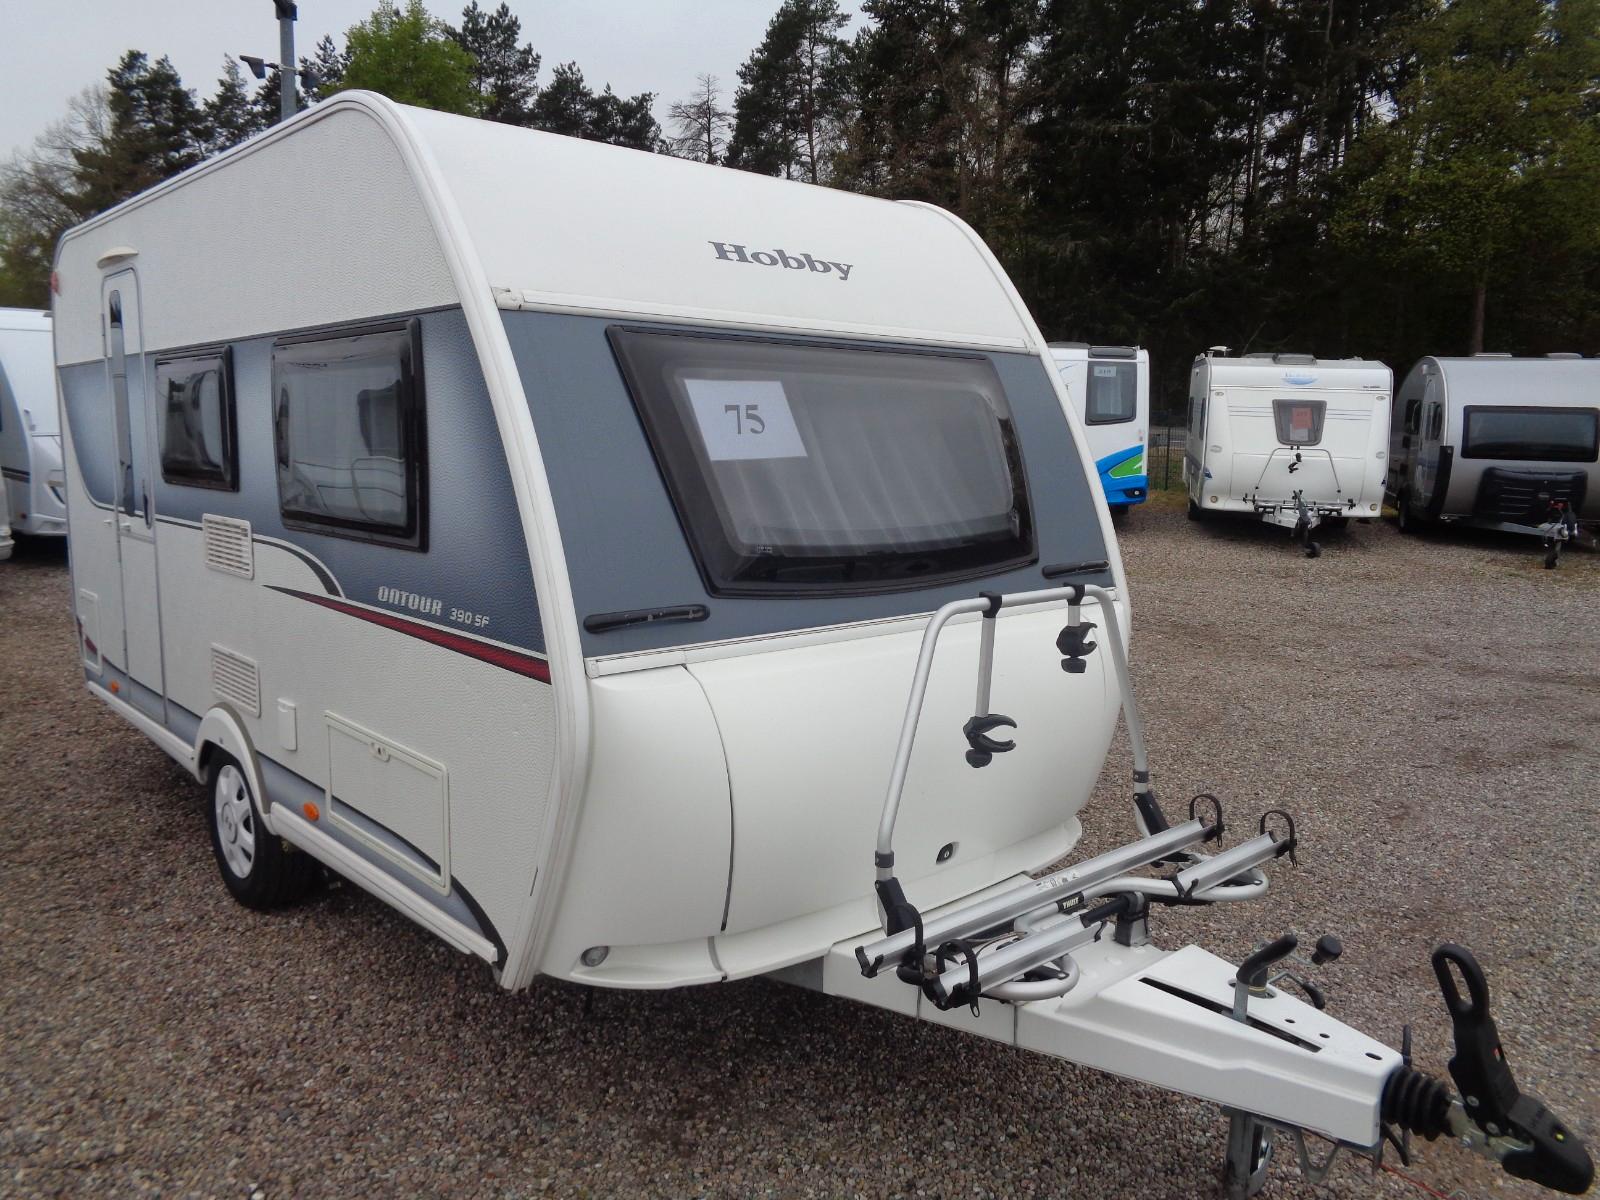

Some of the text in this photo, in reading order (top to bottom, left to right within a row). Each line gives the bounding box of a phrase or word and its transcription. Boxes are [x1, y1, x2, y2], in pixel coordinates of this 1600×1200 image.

[707, 240, 853, 281] Hobby
[724, 404, 766, 435] 75
[377, 585, 490, 628] ONTOUR 390 SF
